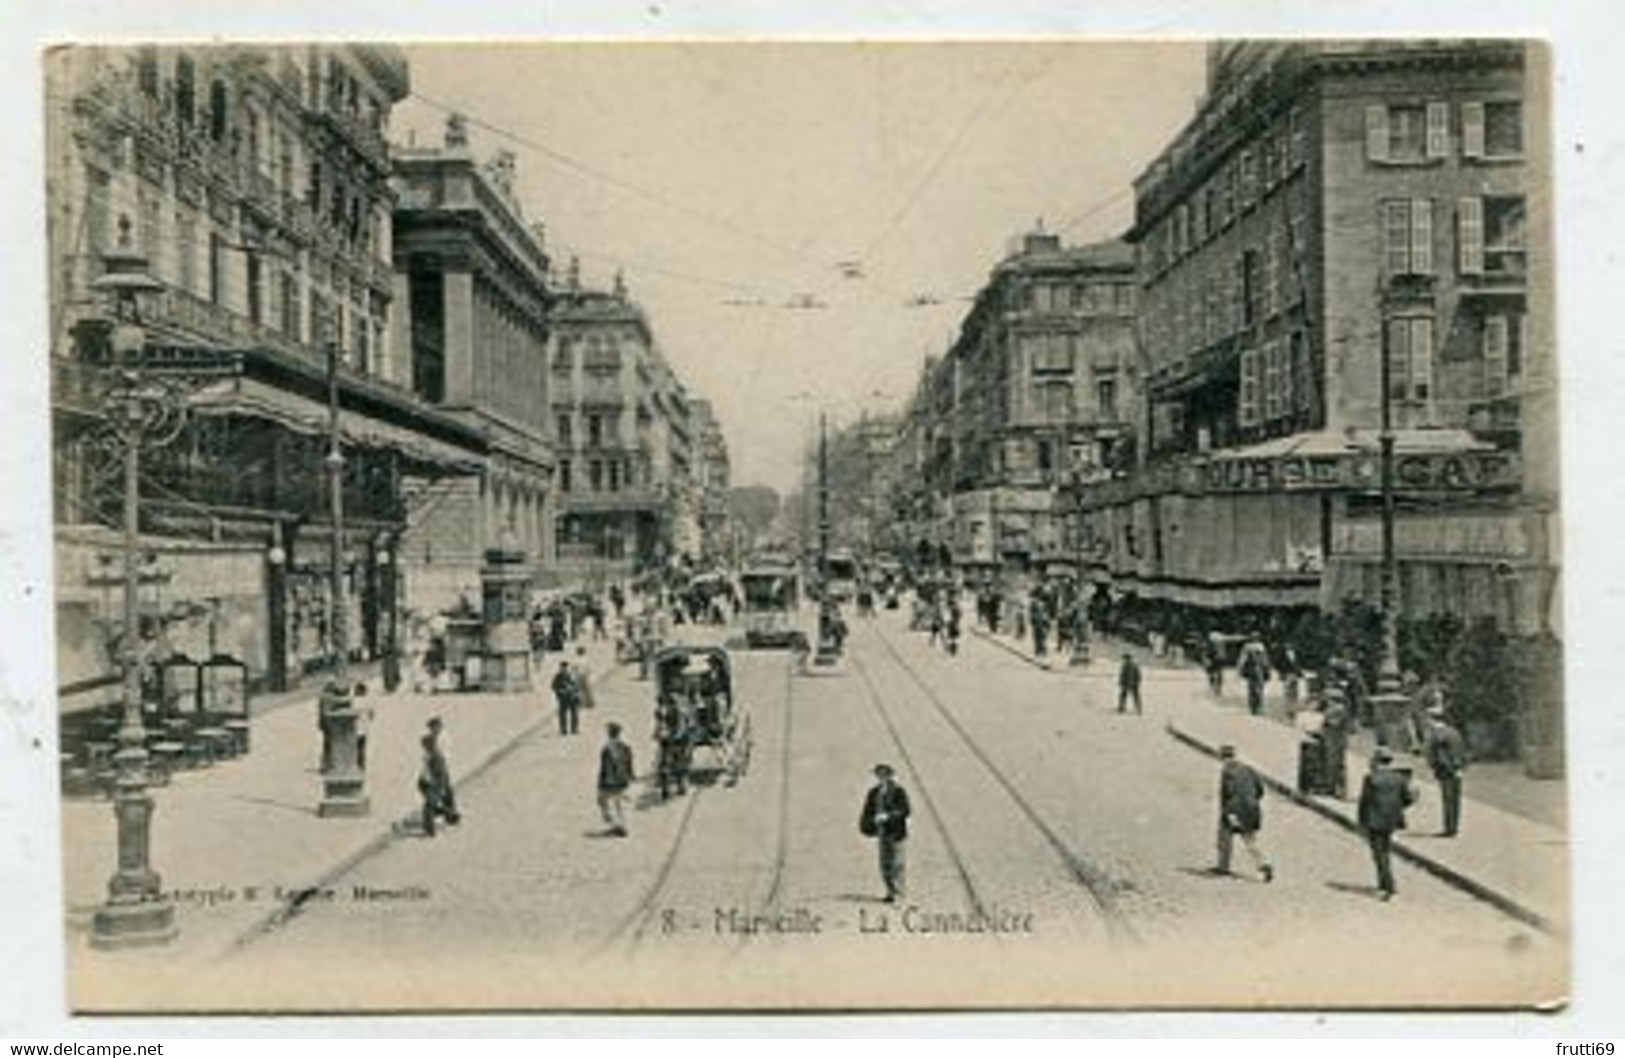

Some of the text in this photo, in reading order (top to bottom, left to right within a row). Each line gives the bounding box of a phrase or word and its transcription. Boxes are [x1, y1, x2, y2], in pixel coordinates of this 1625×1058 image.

[661, 908, 676, 934] 8
[714, 906, 822, 935] Marseille
[859, 907, 889, 934] La
